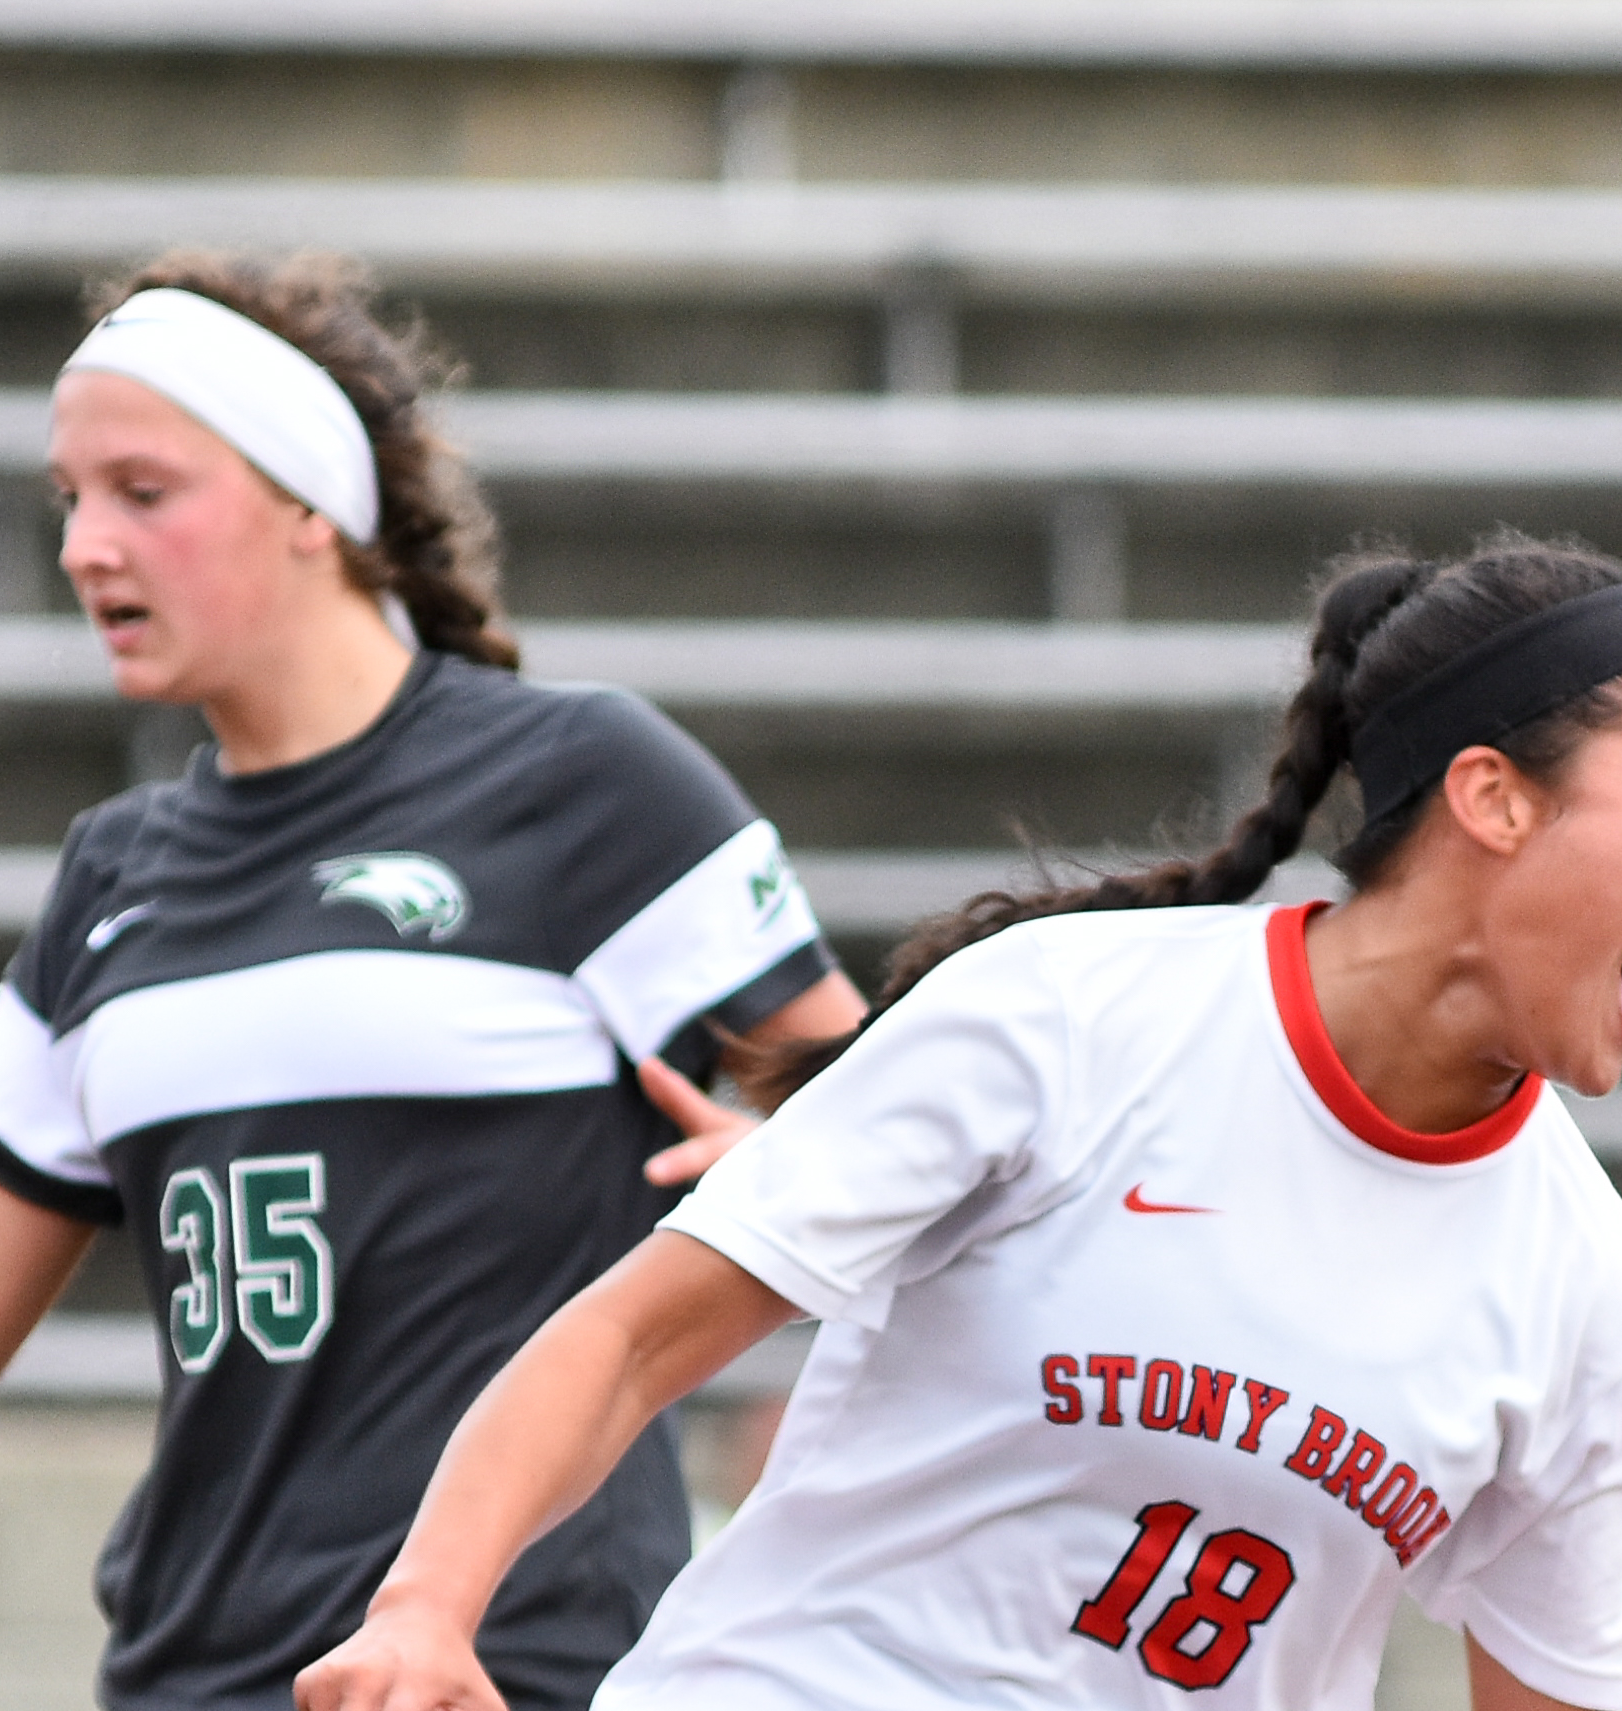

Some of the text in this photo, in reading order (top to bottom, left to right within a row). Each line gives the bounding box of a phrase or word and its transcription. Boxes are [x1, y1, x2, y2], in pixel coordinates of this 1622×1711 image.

[160, 1153, 334, 1374] 35
[1041, 1354, 1290, 1454] STONY
[1071, 1500, 1296, 1692] 18
